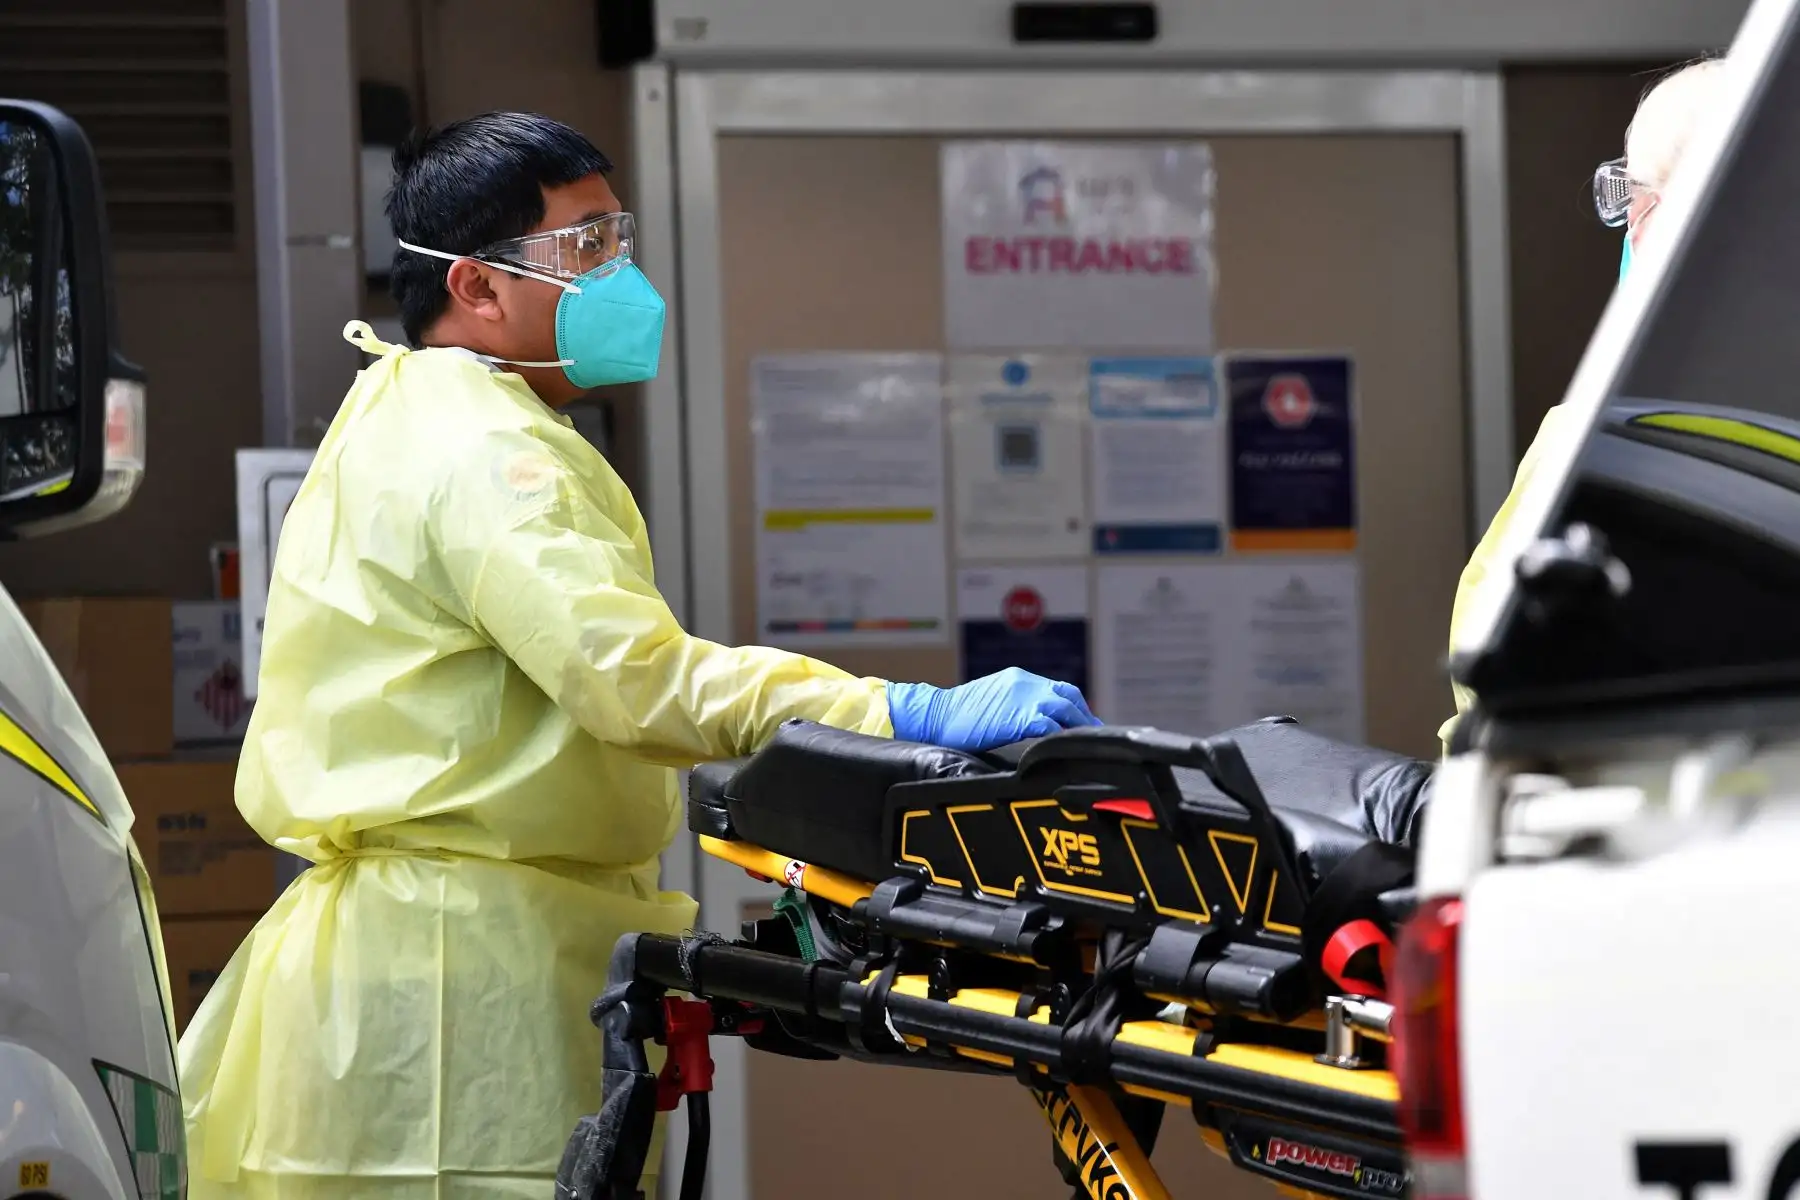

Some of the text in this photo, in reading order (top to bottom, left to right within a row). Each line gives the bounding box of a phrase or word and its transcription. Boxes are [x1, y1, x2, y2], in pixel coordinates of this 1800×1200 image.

[966, 236, 1197, 274] ENTRANCE
[1039, 826, 1100, 870] XPS
[1266, 1136, 1361, 1177] power
